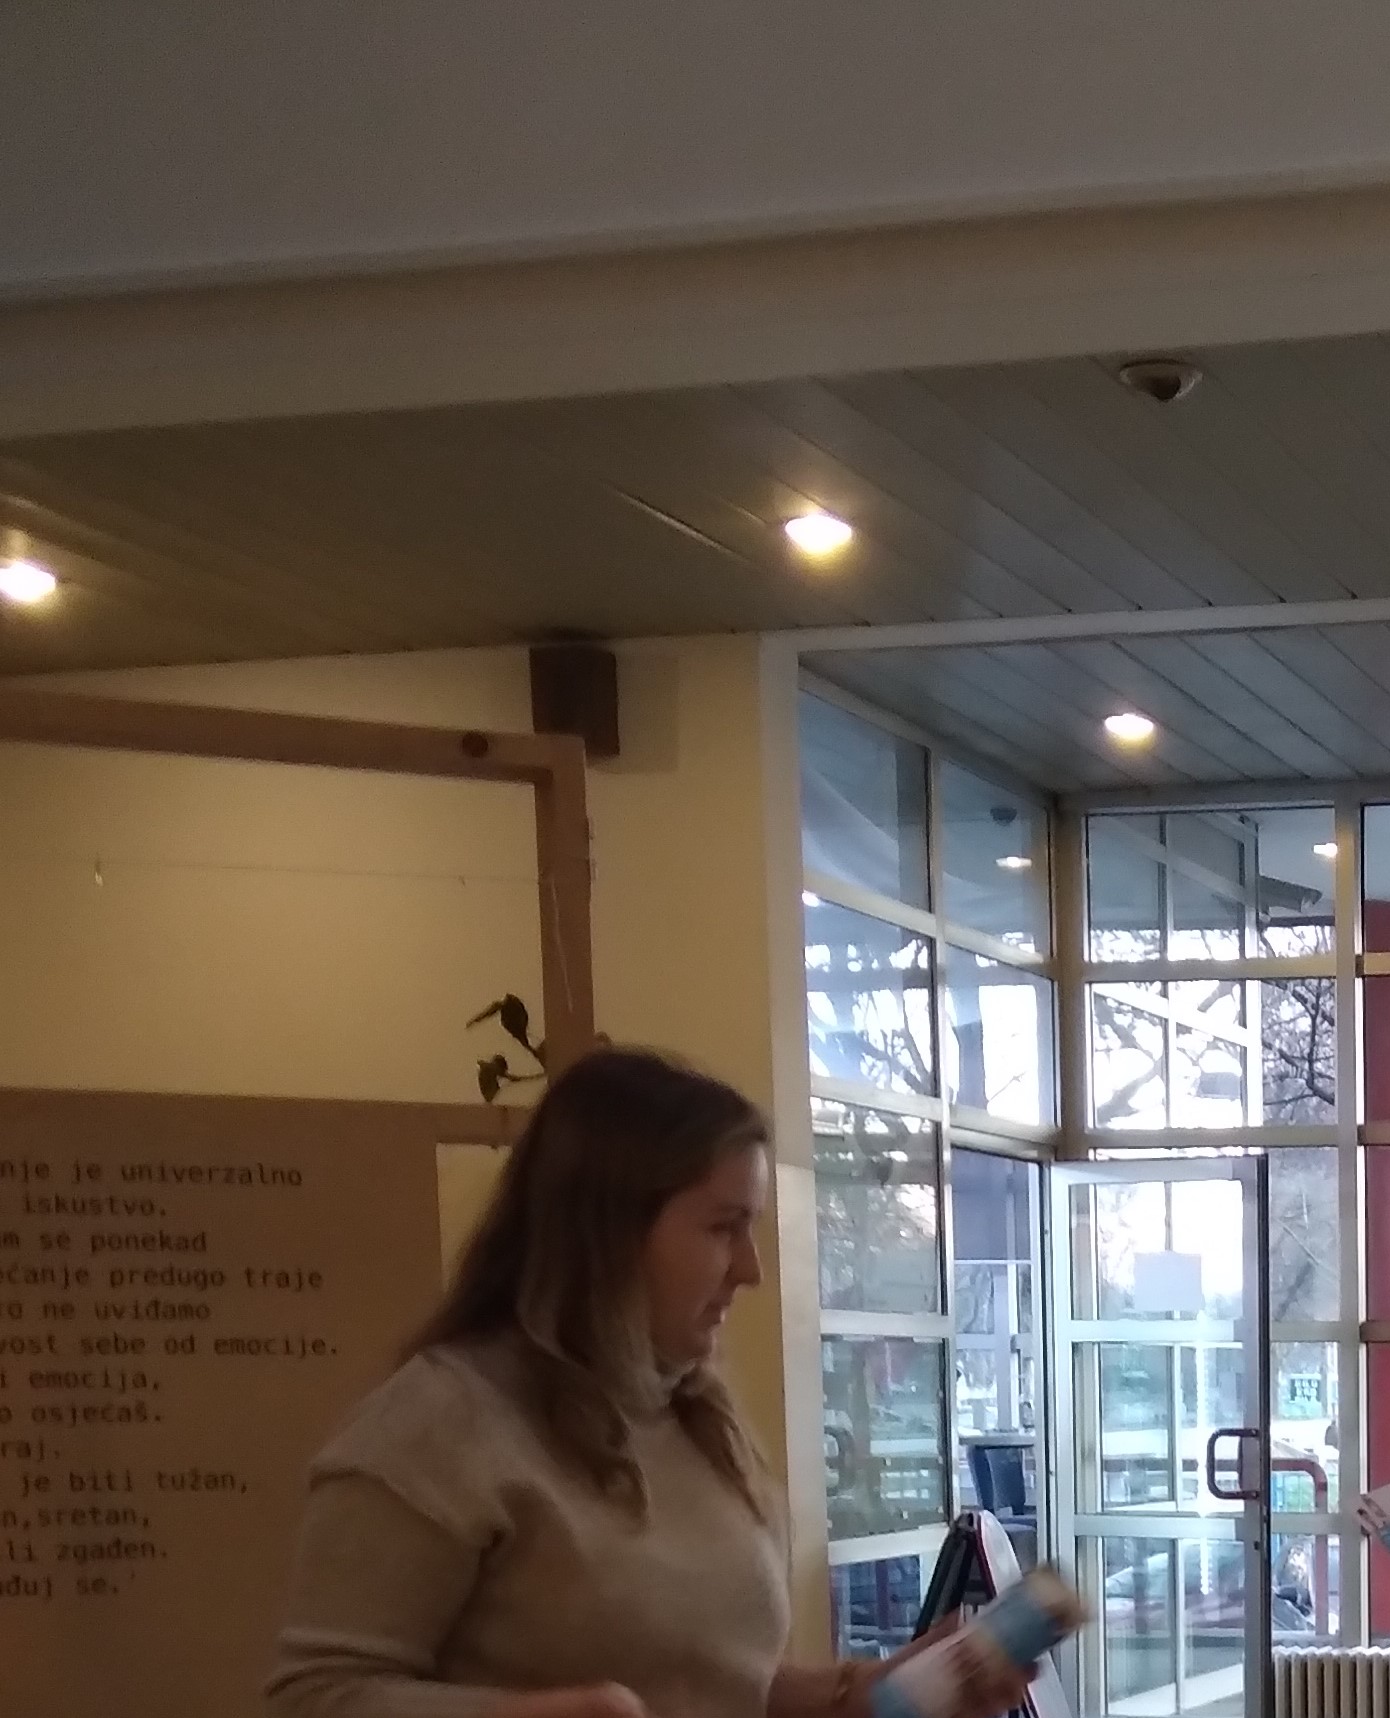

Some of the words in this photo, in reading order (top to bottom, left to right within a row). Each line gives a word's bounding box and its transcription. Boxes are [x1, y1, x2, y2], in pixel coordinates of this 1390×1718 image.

[71, 1159, 102, 1184] je
[121, 1162, 303, 1187] univerzalno
[23, 1194, 166, 1217] iskustvo.
[39, 1231, 71, 1250] se
[91, 1230, 207, 1254] ponekad
[109, 1263, 226, 1291] predugo
[244, 1266, 324, 1292] traje
[43, 1301, 75, 1320] ne
[80, 1332, 146, 1355] sebe
[164, 1334, 196, 1355] od
[213, 1336, 337, 1360] emocije.
[21, 1471, 51, 1498] je
[69, 1468, 133, 1493] biti
[157, 1467, 248, 1494] tužan,
